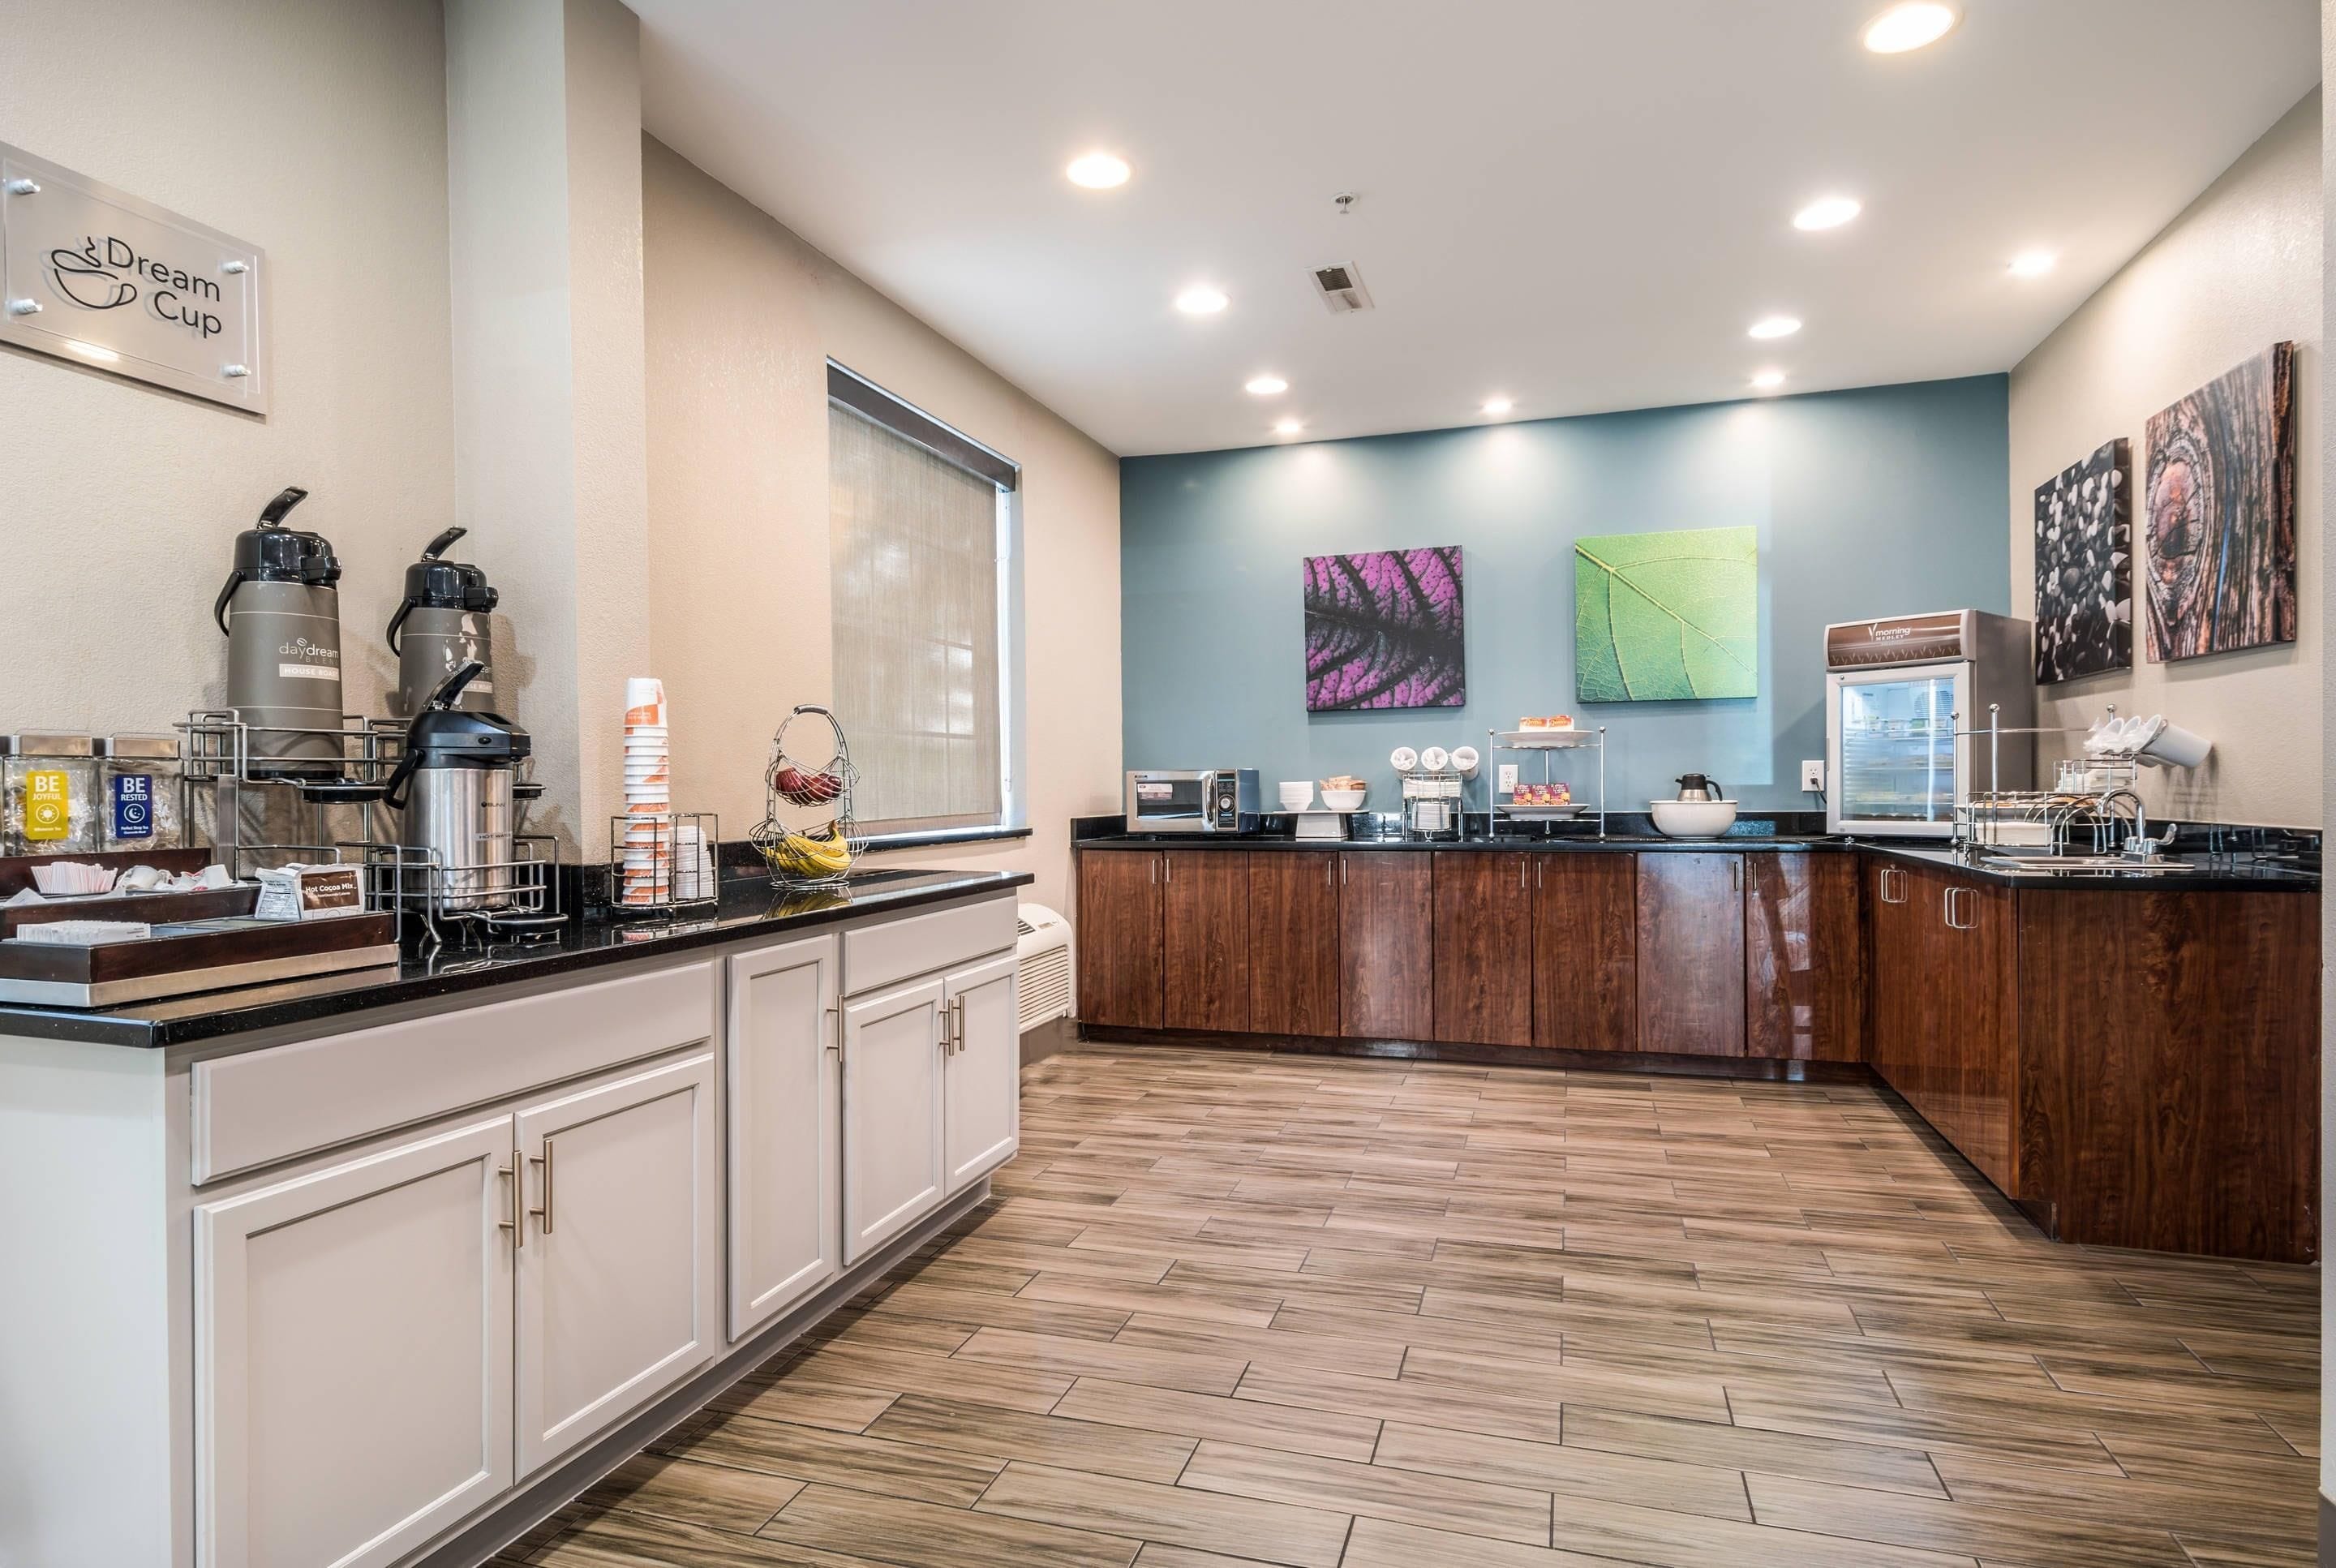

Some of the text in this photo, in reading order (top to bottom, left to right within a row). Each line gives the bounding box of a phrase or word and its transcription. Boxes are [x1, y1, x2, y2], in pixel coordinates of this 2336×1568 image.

[107, 236, 221, 302] Dream
[154, 290, 222, 338] Cup
[1875, 627, 1911, 636] morning
[278, 642, 339, 659] daydream
[284, 668, 316, 676] HOUSE
[35, 775, 60, 793] BE
[123, 777, 146, 793] BE
[32, 793, 62, 801] JOYFUL
